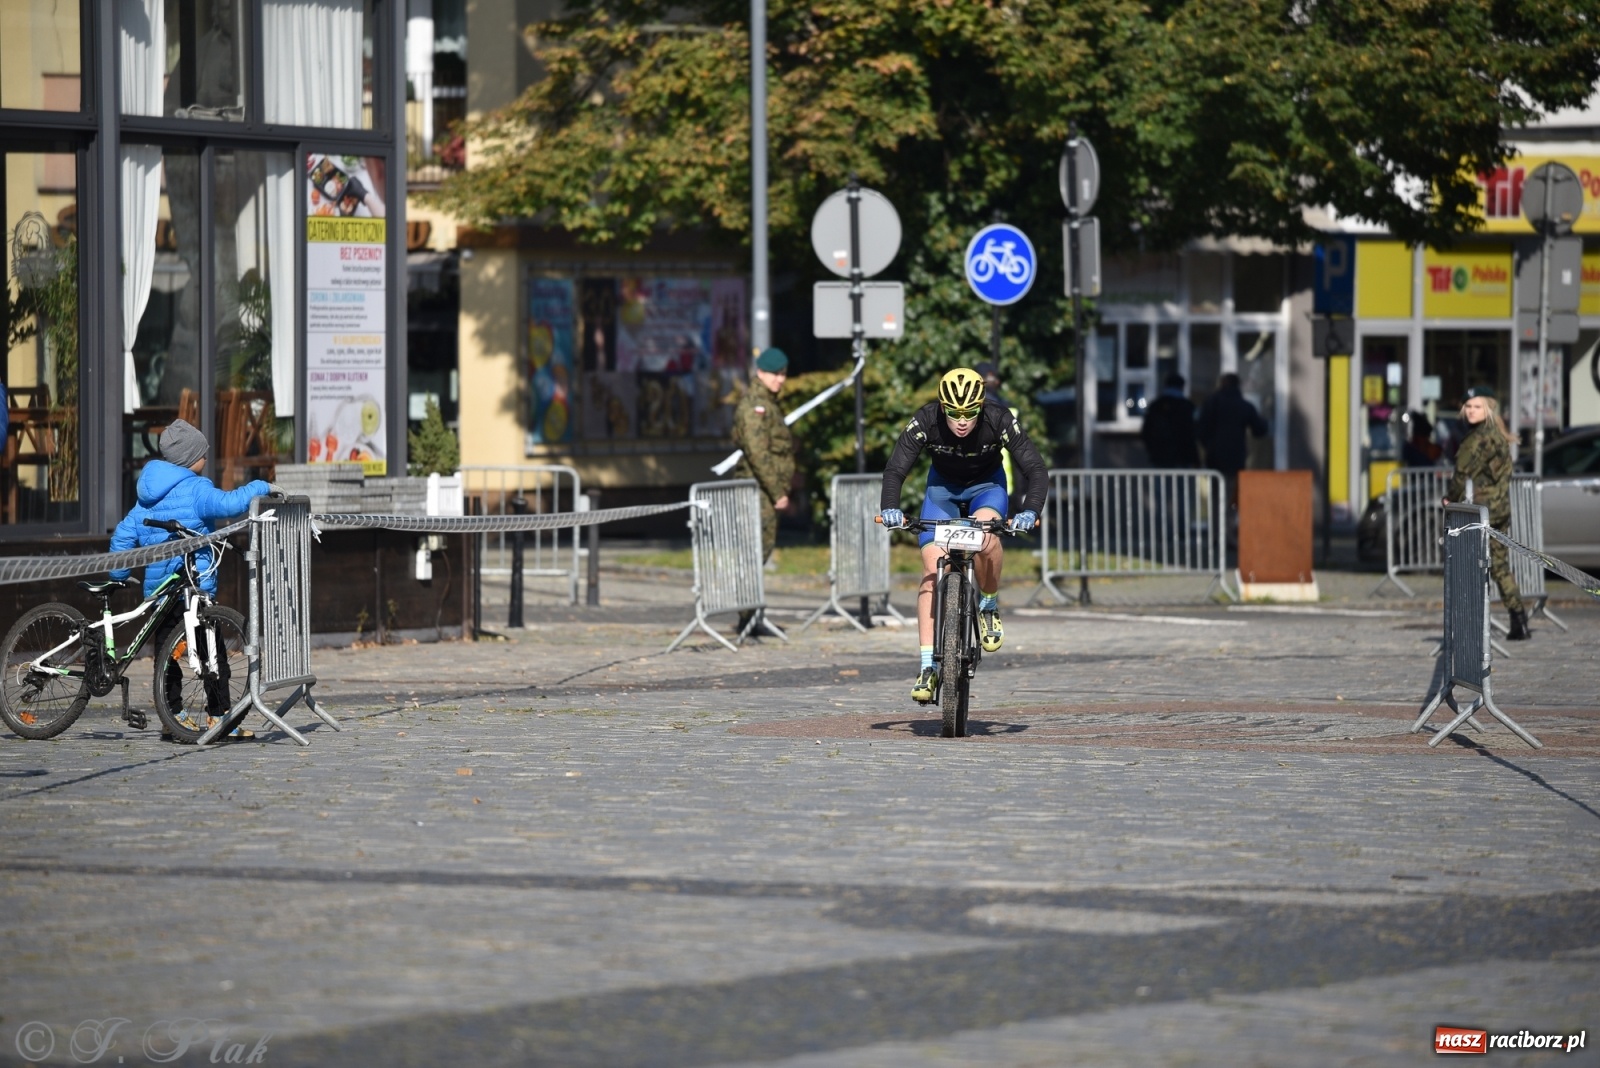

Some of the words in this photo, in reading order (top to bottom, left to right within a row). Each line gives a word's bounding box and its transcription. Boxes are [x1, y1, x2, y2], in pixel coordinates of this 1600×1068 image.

[308, 220, 339, 241] CATERING
[340, 221, 384, 242] DIETETYCZNY
[340, 246, 352, 260] BEZ
[353, 246, 383, 260] PSZENICY
